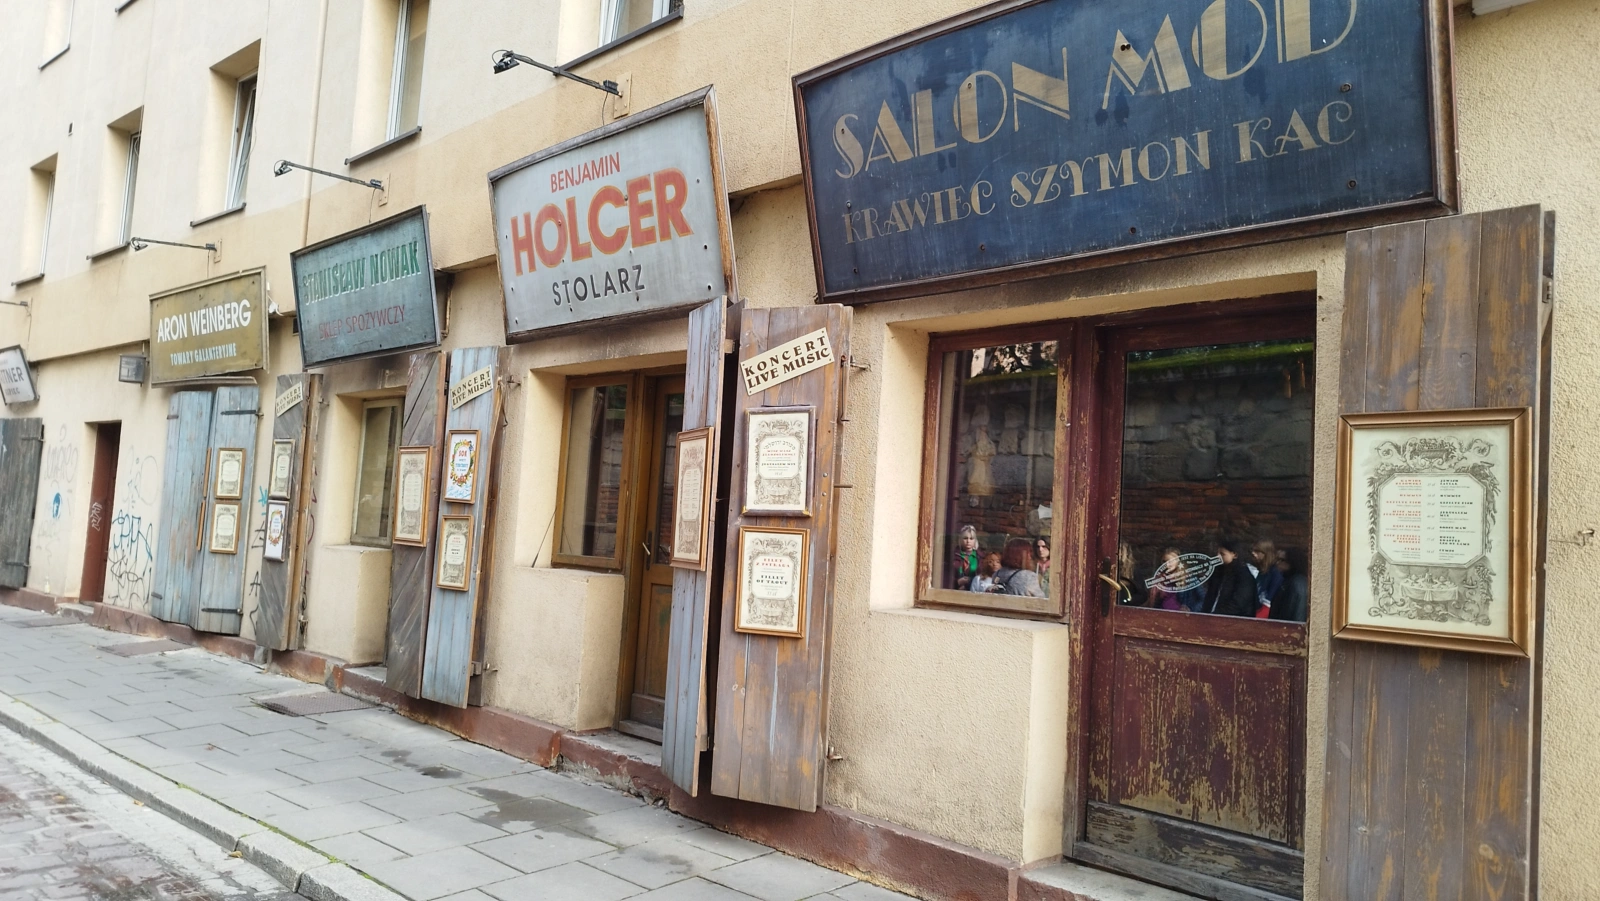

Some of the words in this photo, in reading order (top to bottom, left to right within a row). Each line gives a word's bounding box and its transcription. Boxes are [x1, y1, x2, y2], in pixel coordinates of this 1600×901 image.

[832, 47, 1070, 179] SALON
[550, 151, 621, 194] BENJAMIN
[841, 180, 996, 245] KRAWIEC
[1010, 130, 1212, 208] SZYMON
[1233, 100, 1356, 164] KAC
[510, 167, 695, 277] HOLCER
[369, 240, 422, 287] NOWAK
[552, 264, 645, 306] STOLARZ
[157, 312, 188, 343] ARON
[189, 298, 252, 336] WEINBERG
[318, 319, 342, 340] SKLEP
[170, 350, 193, 366] TOWARY
[744, 336, 825, 377] KONCERT
[746, 368, 779, 389] LIVE
[782, 347, 831, 374] MUSIC
[451, 370, 490, 398] KONCERT
[467, 379, 491, 397] MUSIC
